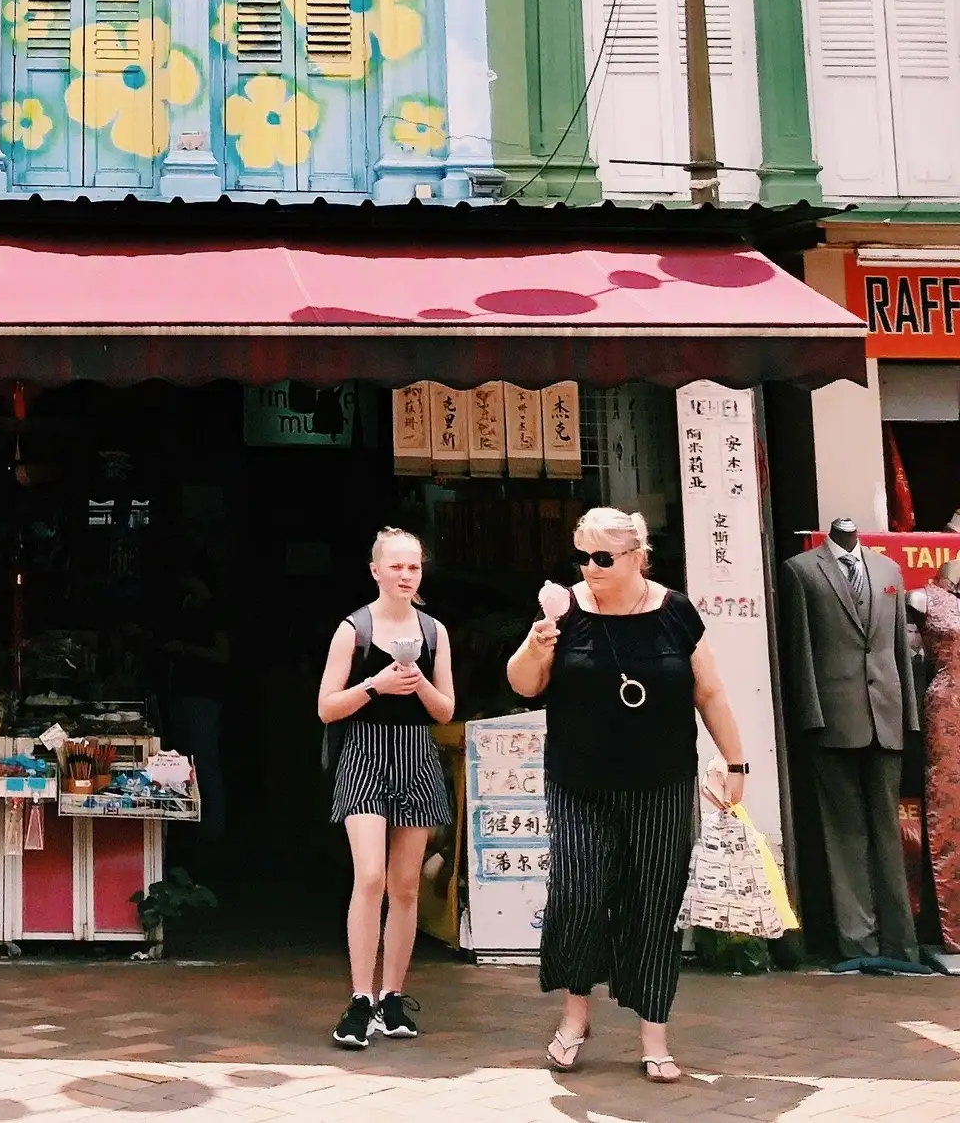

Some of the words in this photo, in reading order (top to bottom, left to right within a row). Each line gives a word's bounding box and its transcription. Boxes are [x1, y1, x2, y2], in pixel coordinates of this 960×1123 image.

[863, 275, 960, 335] RAFF
[686, 428, 707, 489] 阿米莉亚
